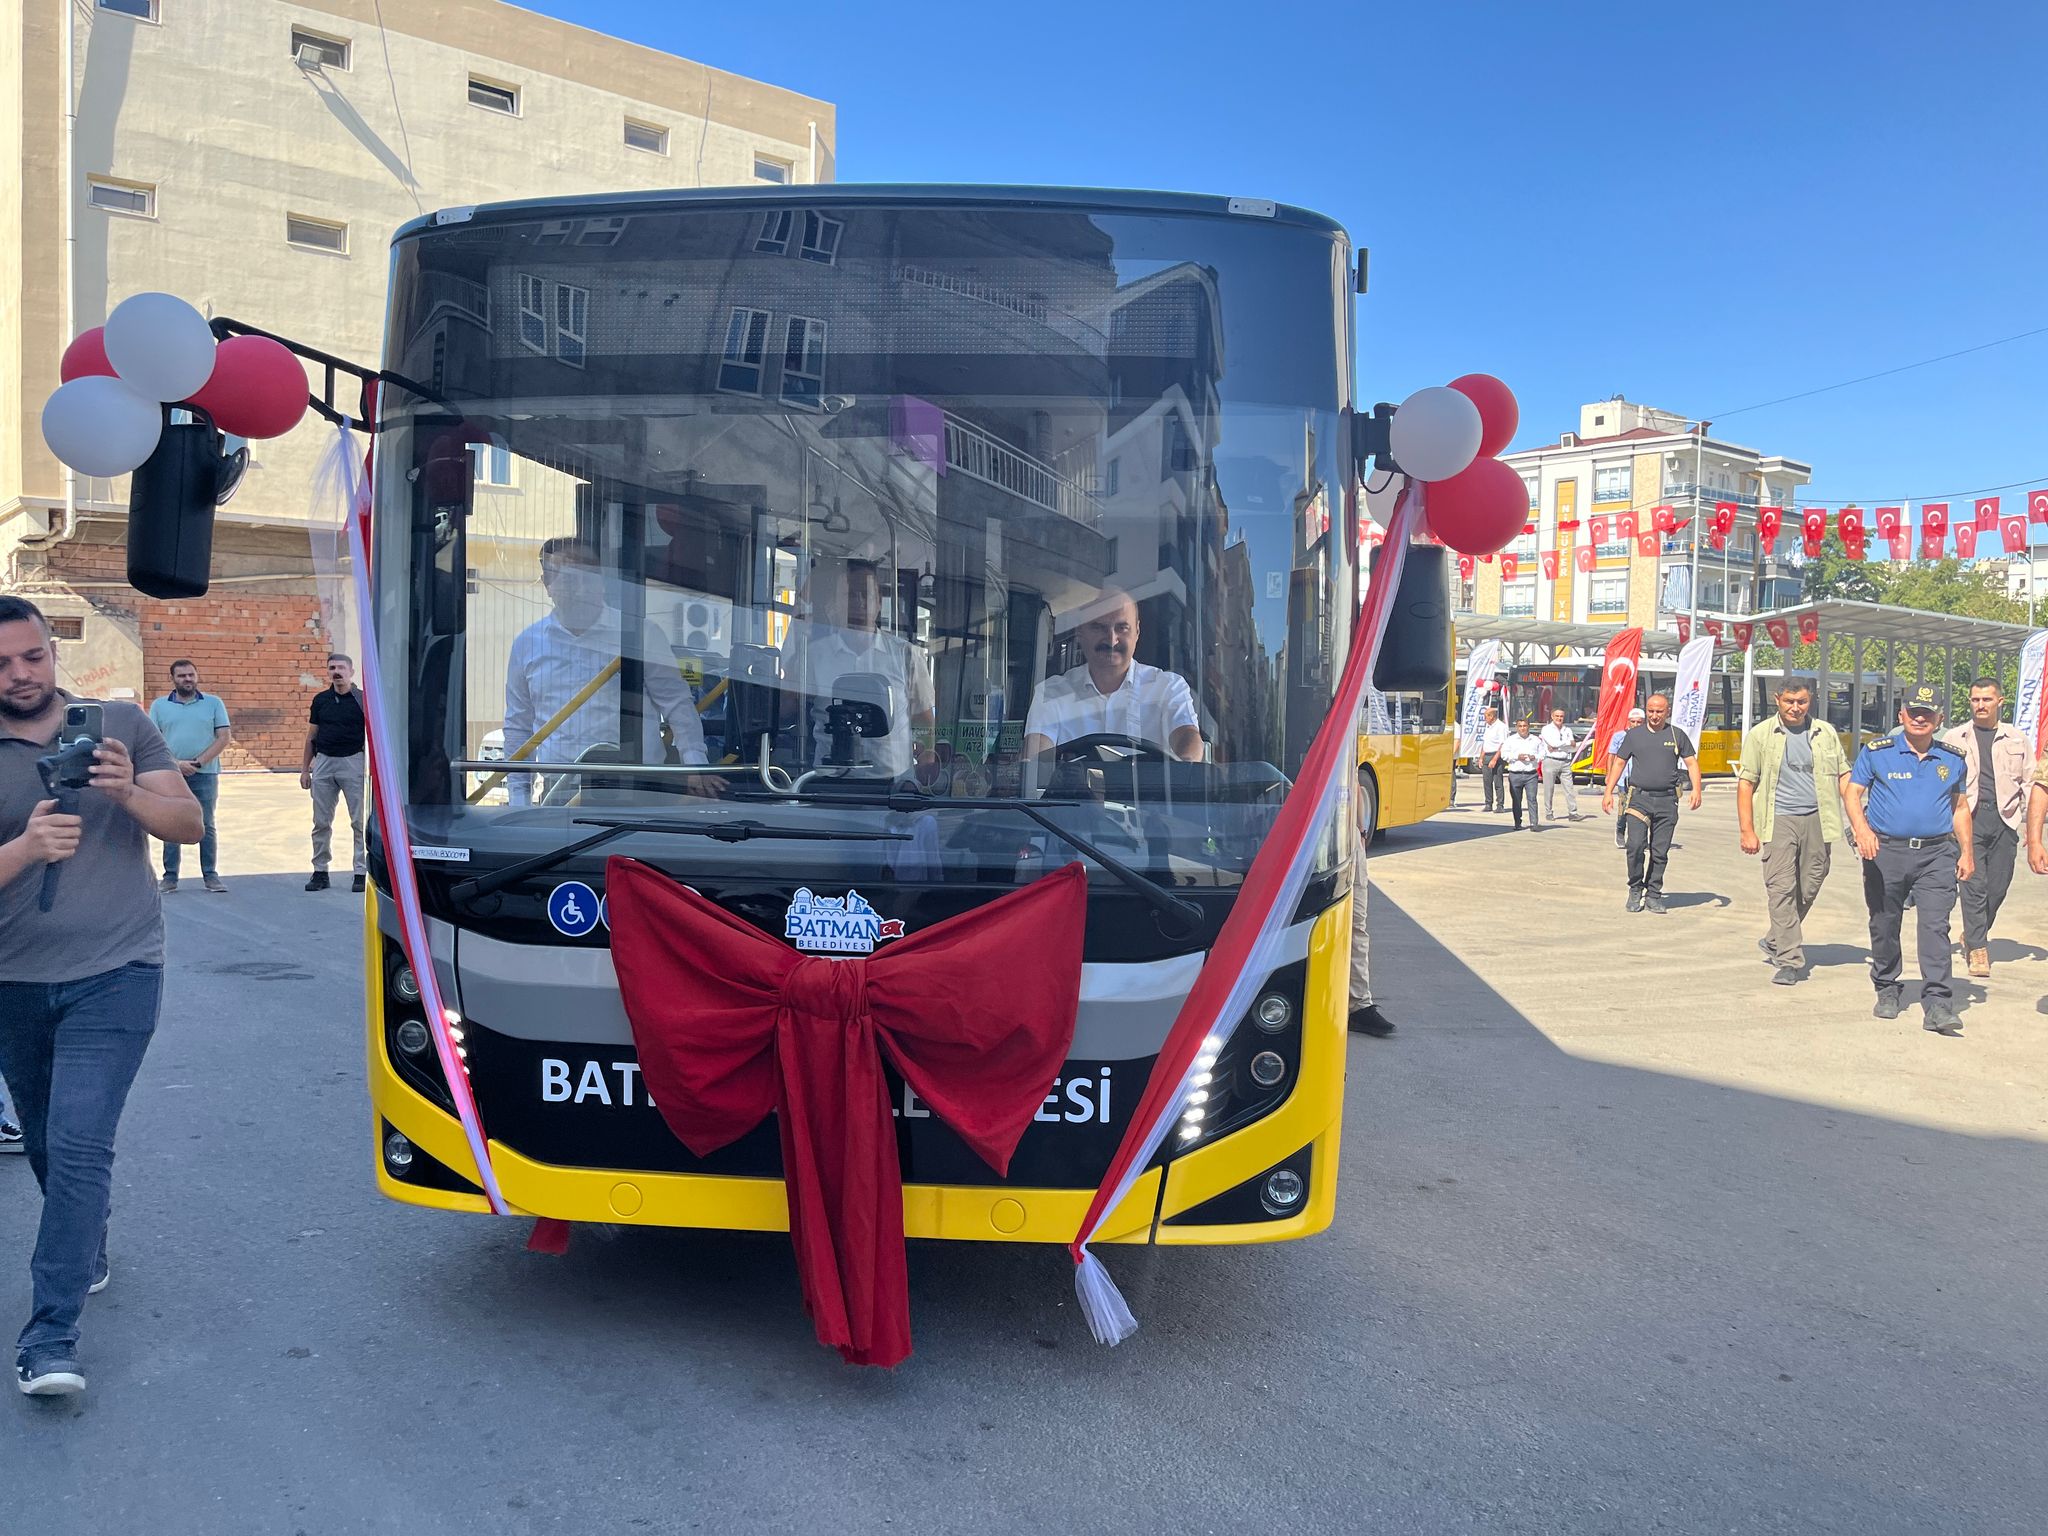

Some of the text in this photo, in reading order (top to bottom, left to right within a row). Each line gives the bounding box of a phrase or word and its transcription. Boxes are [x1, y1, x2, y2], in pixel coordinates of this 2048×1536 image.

[1687, 688, 1699, 728] BATMAN
[2019, 679, 2037, 736] ATMAN
[786, 915, 882, 940] BATMAN
[798, 940, 872, 950] BELEDİYESİ
[542, 1058, 657, 1107] BAT
